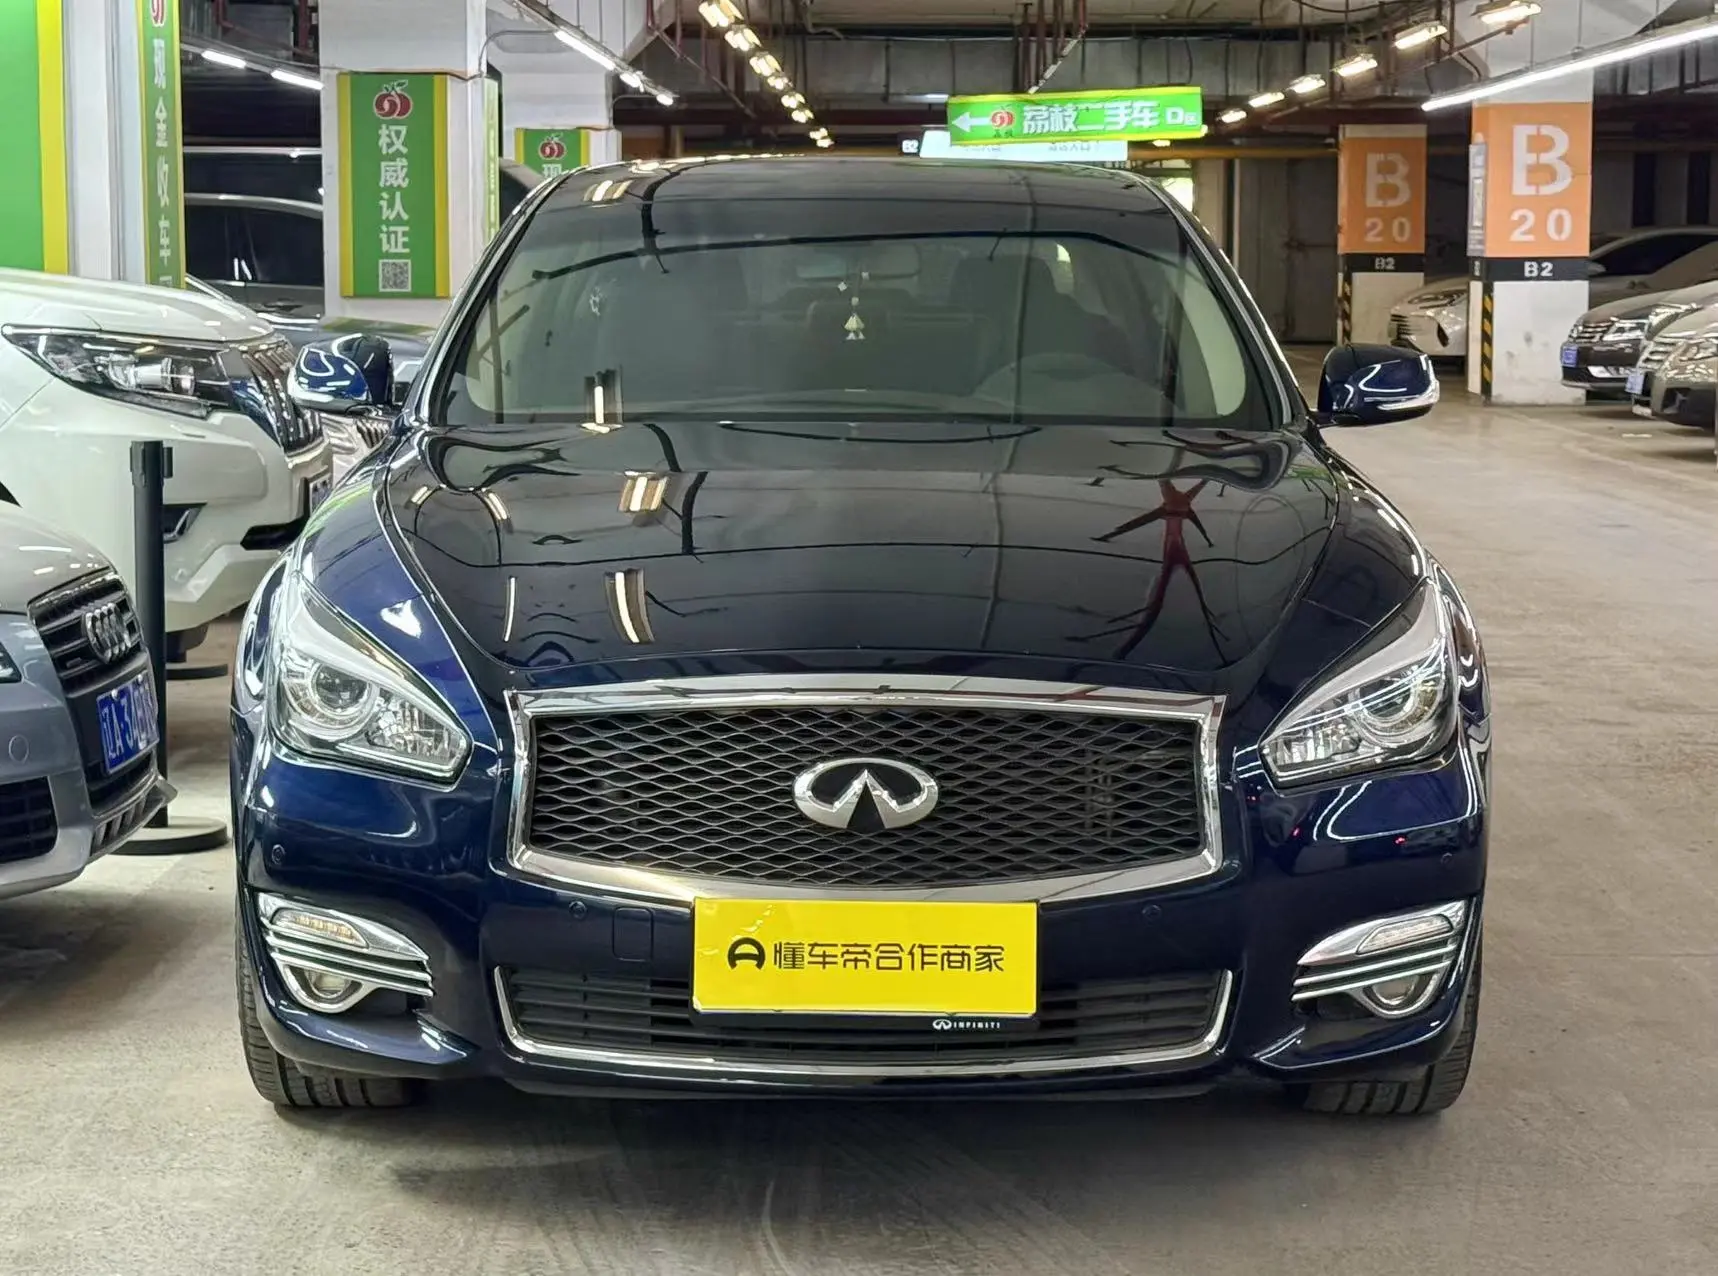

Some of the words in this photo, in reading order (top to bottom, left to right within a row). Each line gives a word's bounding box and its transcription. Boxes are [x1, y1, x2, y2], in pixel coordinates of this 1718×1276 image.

[1022, 100, 1159, 134] 荔枝二手车
[152, 38, 171, 267] 现金收车
[1512, 124, 1574, 195] B
[378, 123, 410, 254] 权威认证
[1366, 152, 1412, 208] B
[1365, 217, 1412, 243] 20
[1509, 208, 1574, 242] 20
[1375, 256, 1396, 271] B2
[1523, 260, 1555, 278] B2
[773, 941, 1005, 972] 懂车帝合作商家
[953, 1021, 1001, 1029] INFINITI
